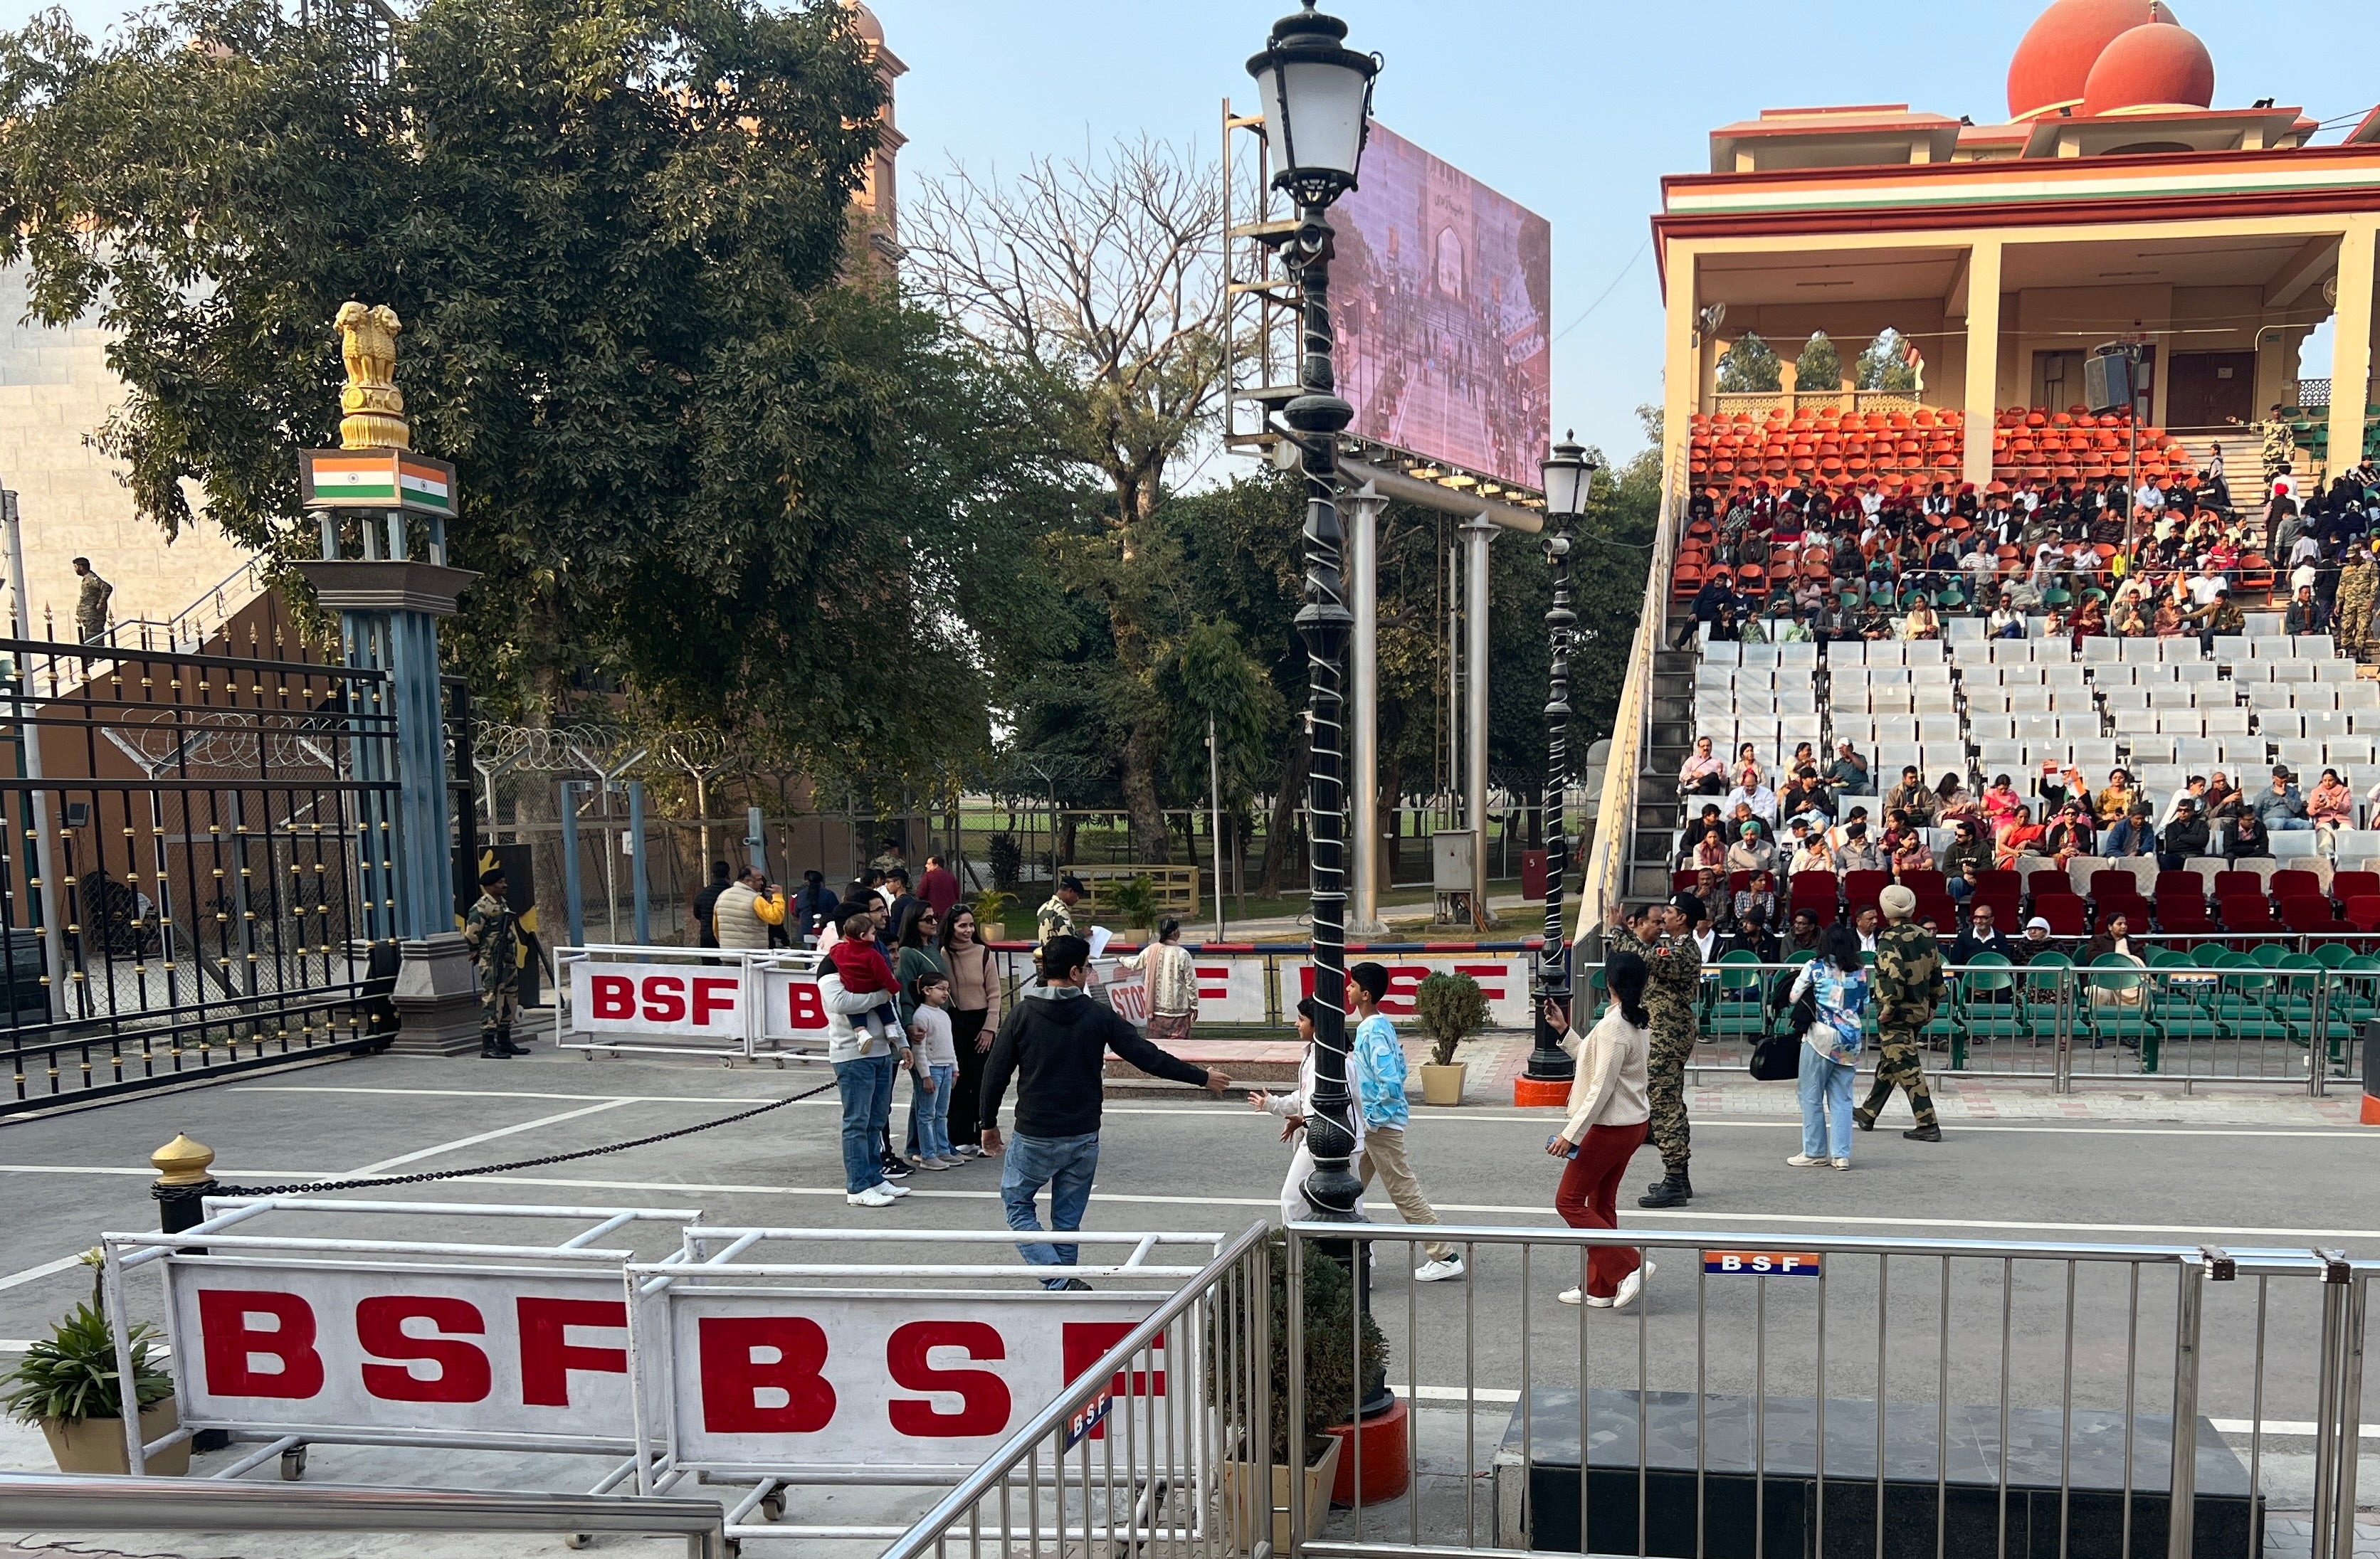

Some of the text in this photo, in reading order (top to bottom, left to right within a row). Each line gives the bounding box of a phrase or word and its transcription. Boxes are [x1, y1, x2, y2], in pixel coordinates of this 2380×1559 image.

[1529, 858, 1536, 867] 5
[591, 975, 739, 1025] BSF
[1722, 1255, 1800, 1272] BSF
[199, 1289, 628, 1407] BSF
[698, 1316, 1166, 1440] BSF
[1073, 1392, 1105, 1438] BSF
